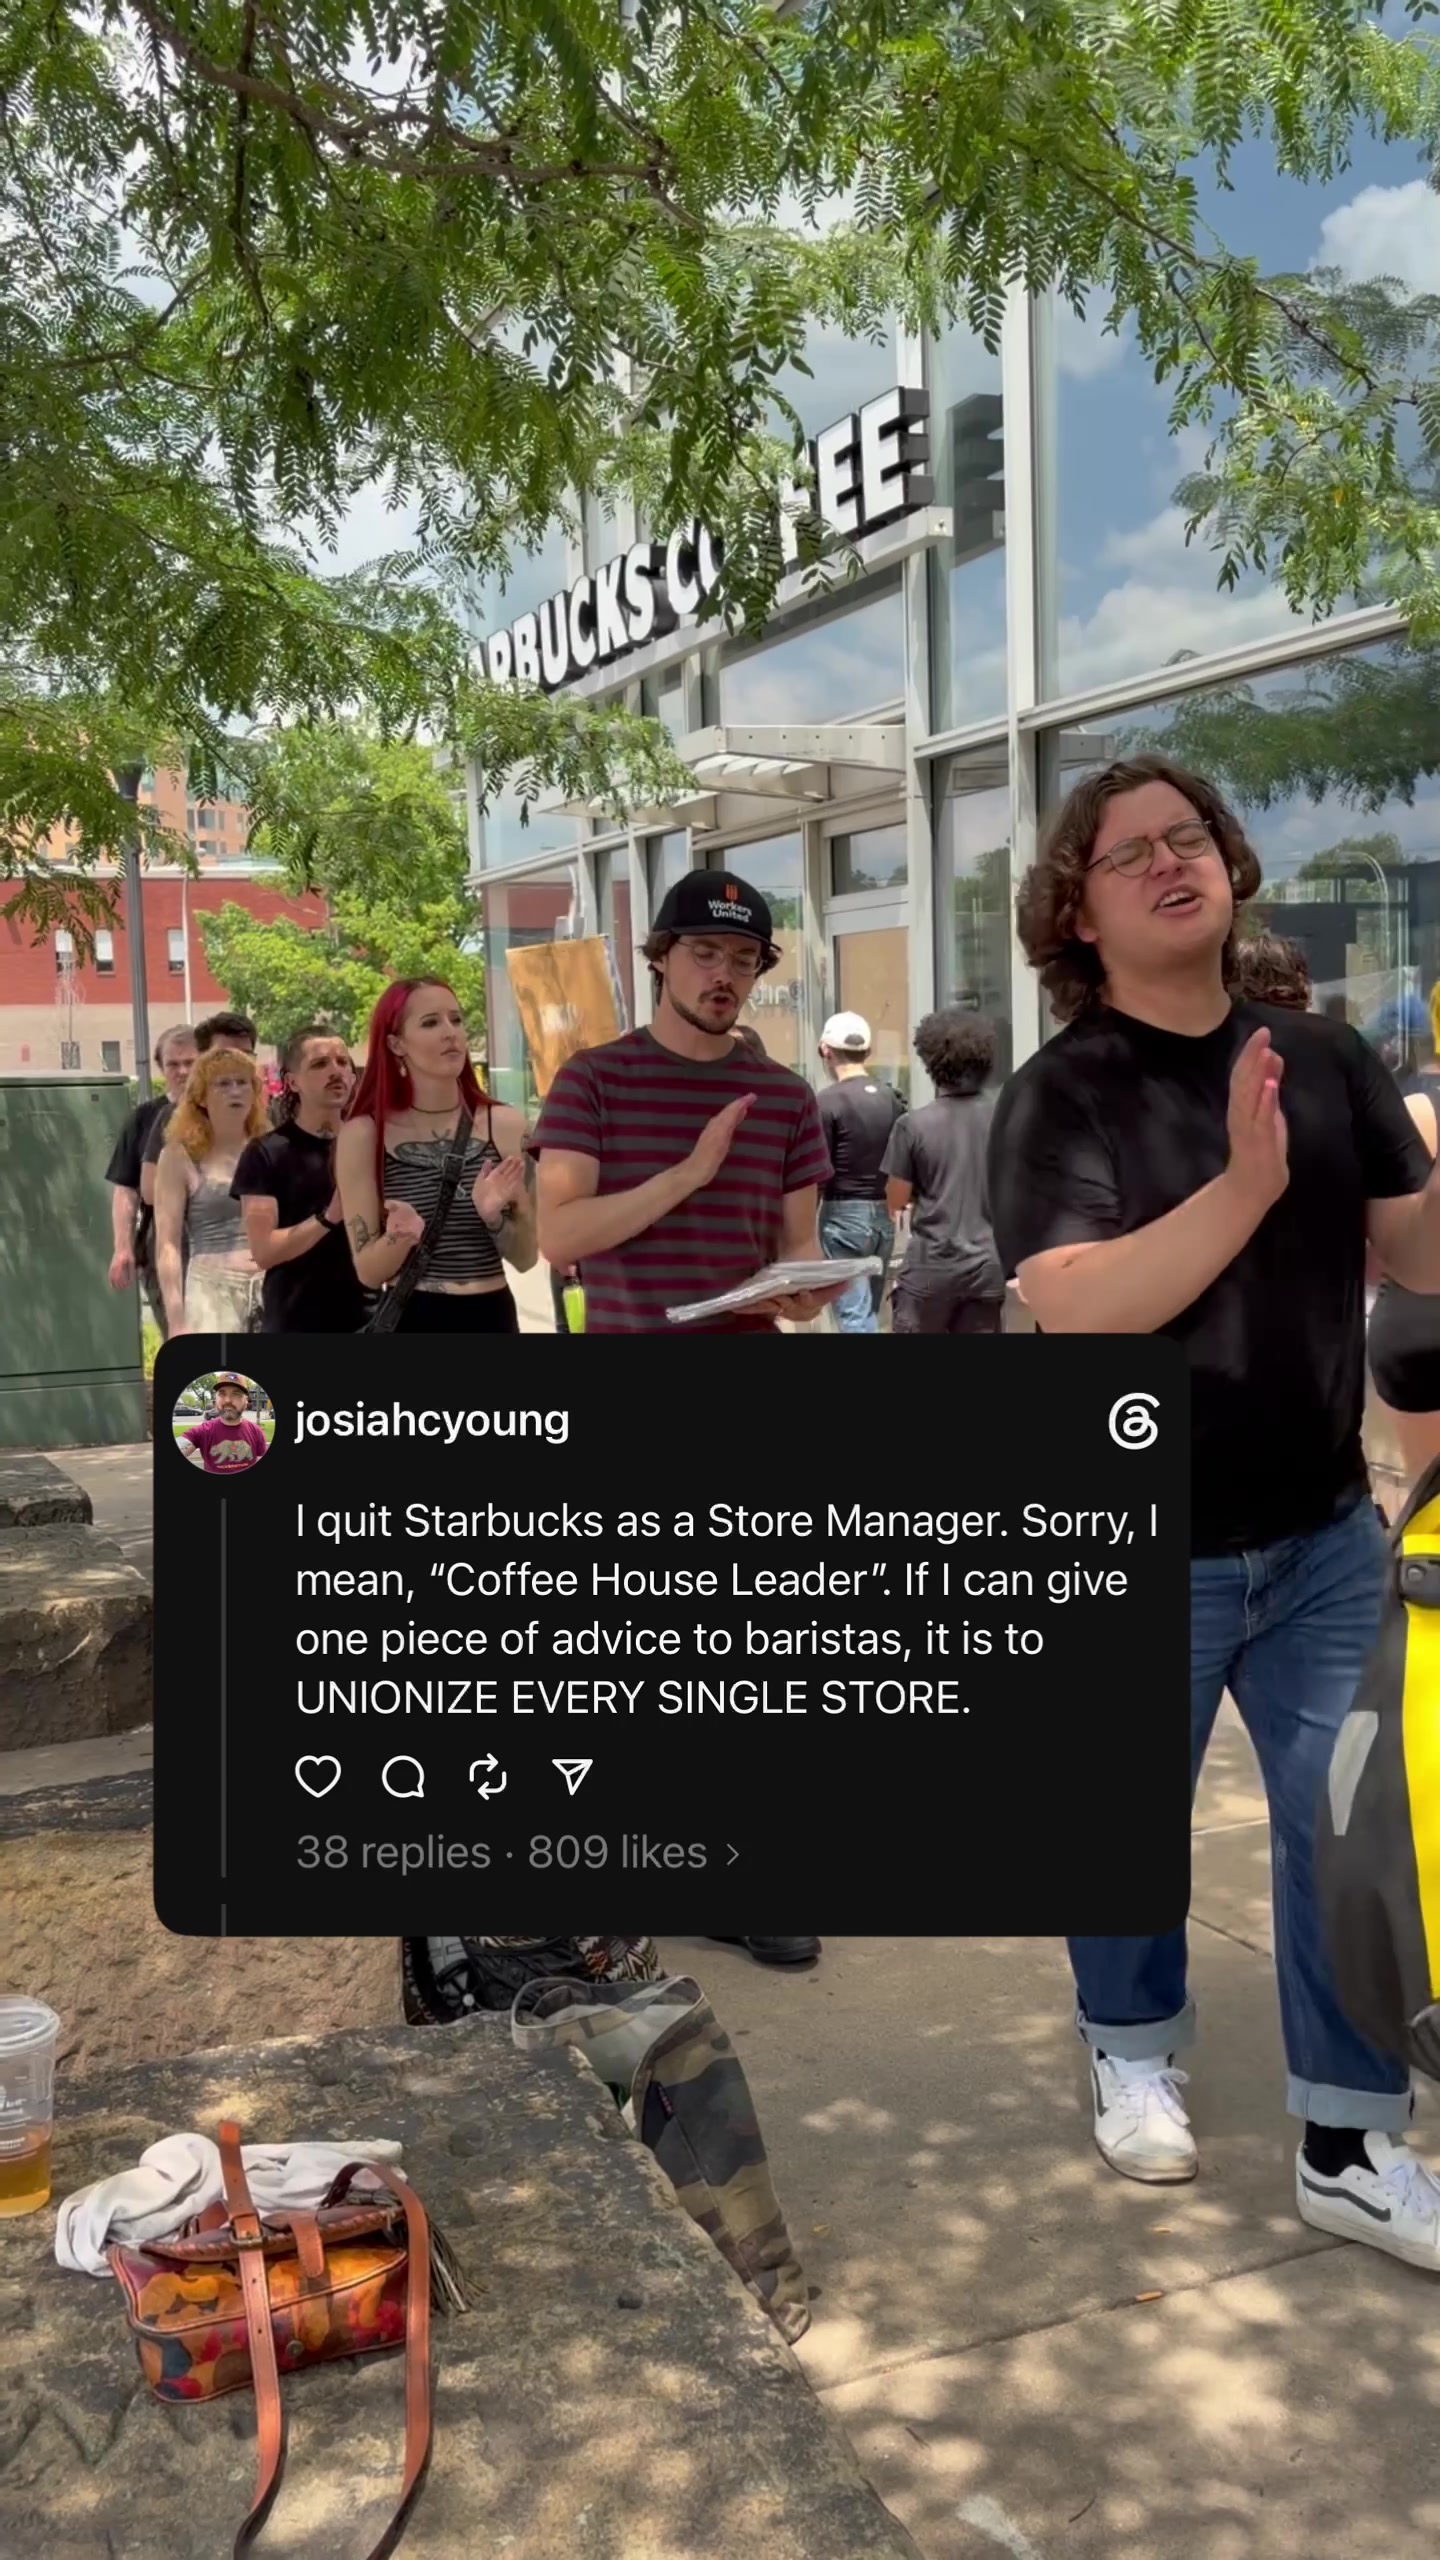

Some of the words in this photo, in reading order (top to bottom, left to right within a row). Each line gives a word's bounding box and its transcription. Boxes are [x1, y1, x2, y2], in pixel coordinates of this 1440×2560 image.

[467, 542, 656, 690] RBUCKS
[665, 386, 912, 615] CEE
[708, 899, 752, 917] Workers
[712, 908, 750, 923] United
